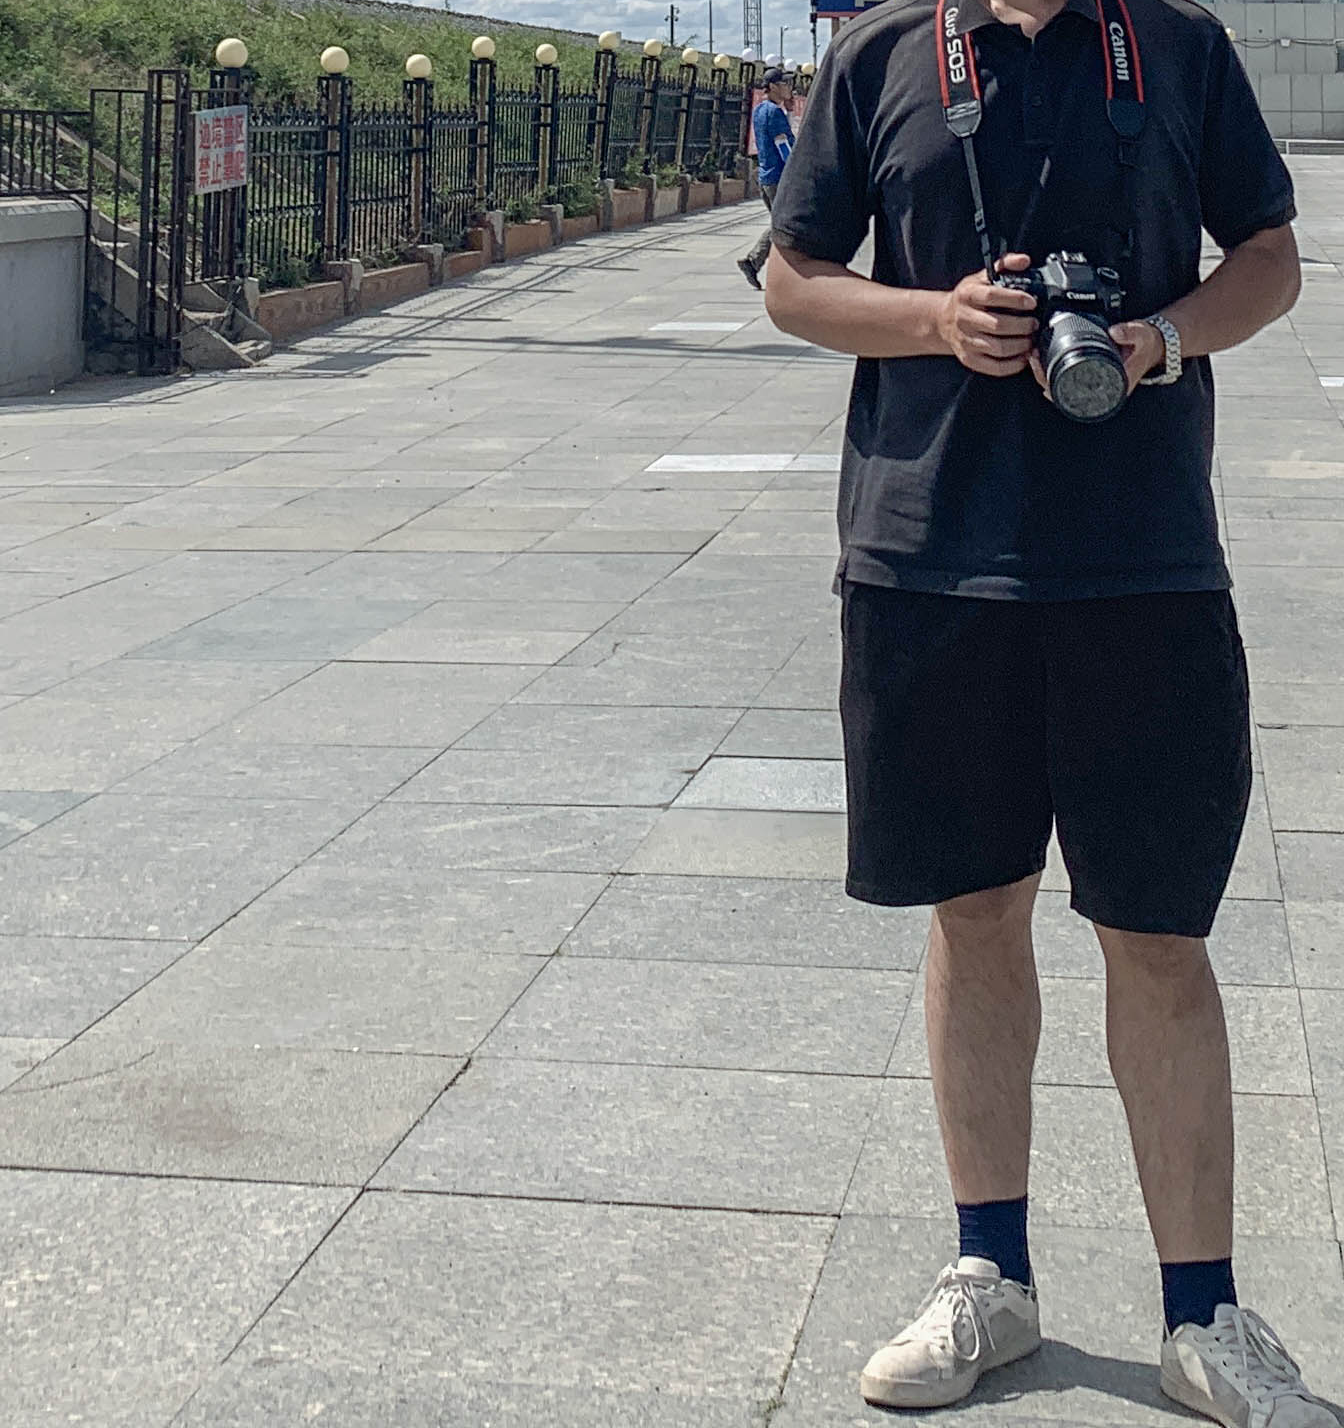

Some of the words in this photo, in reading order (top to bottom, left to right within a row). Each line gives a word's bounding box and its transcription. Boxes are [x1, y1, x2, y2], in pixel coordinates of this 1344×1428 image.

[947, 38, 968, 84] EOS
[1108, 21, 1130, 82] Canon
[199, 114, 245, 149] 边境禁区
[199, 150, 245, 188] 禁止攀爬
